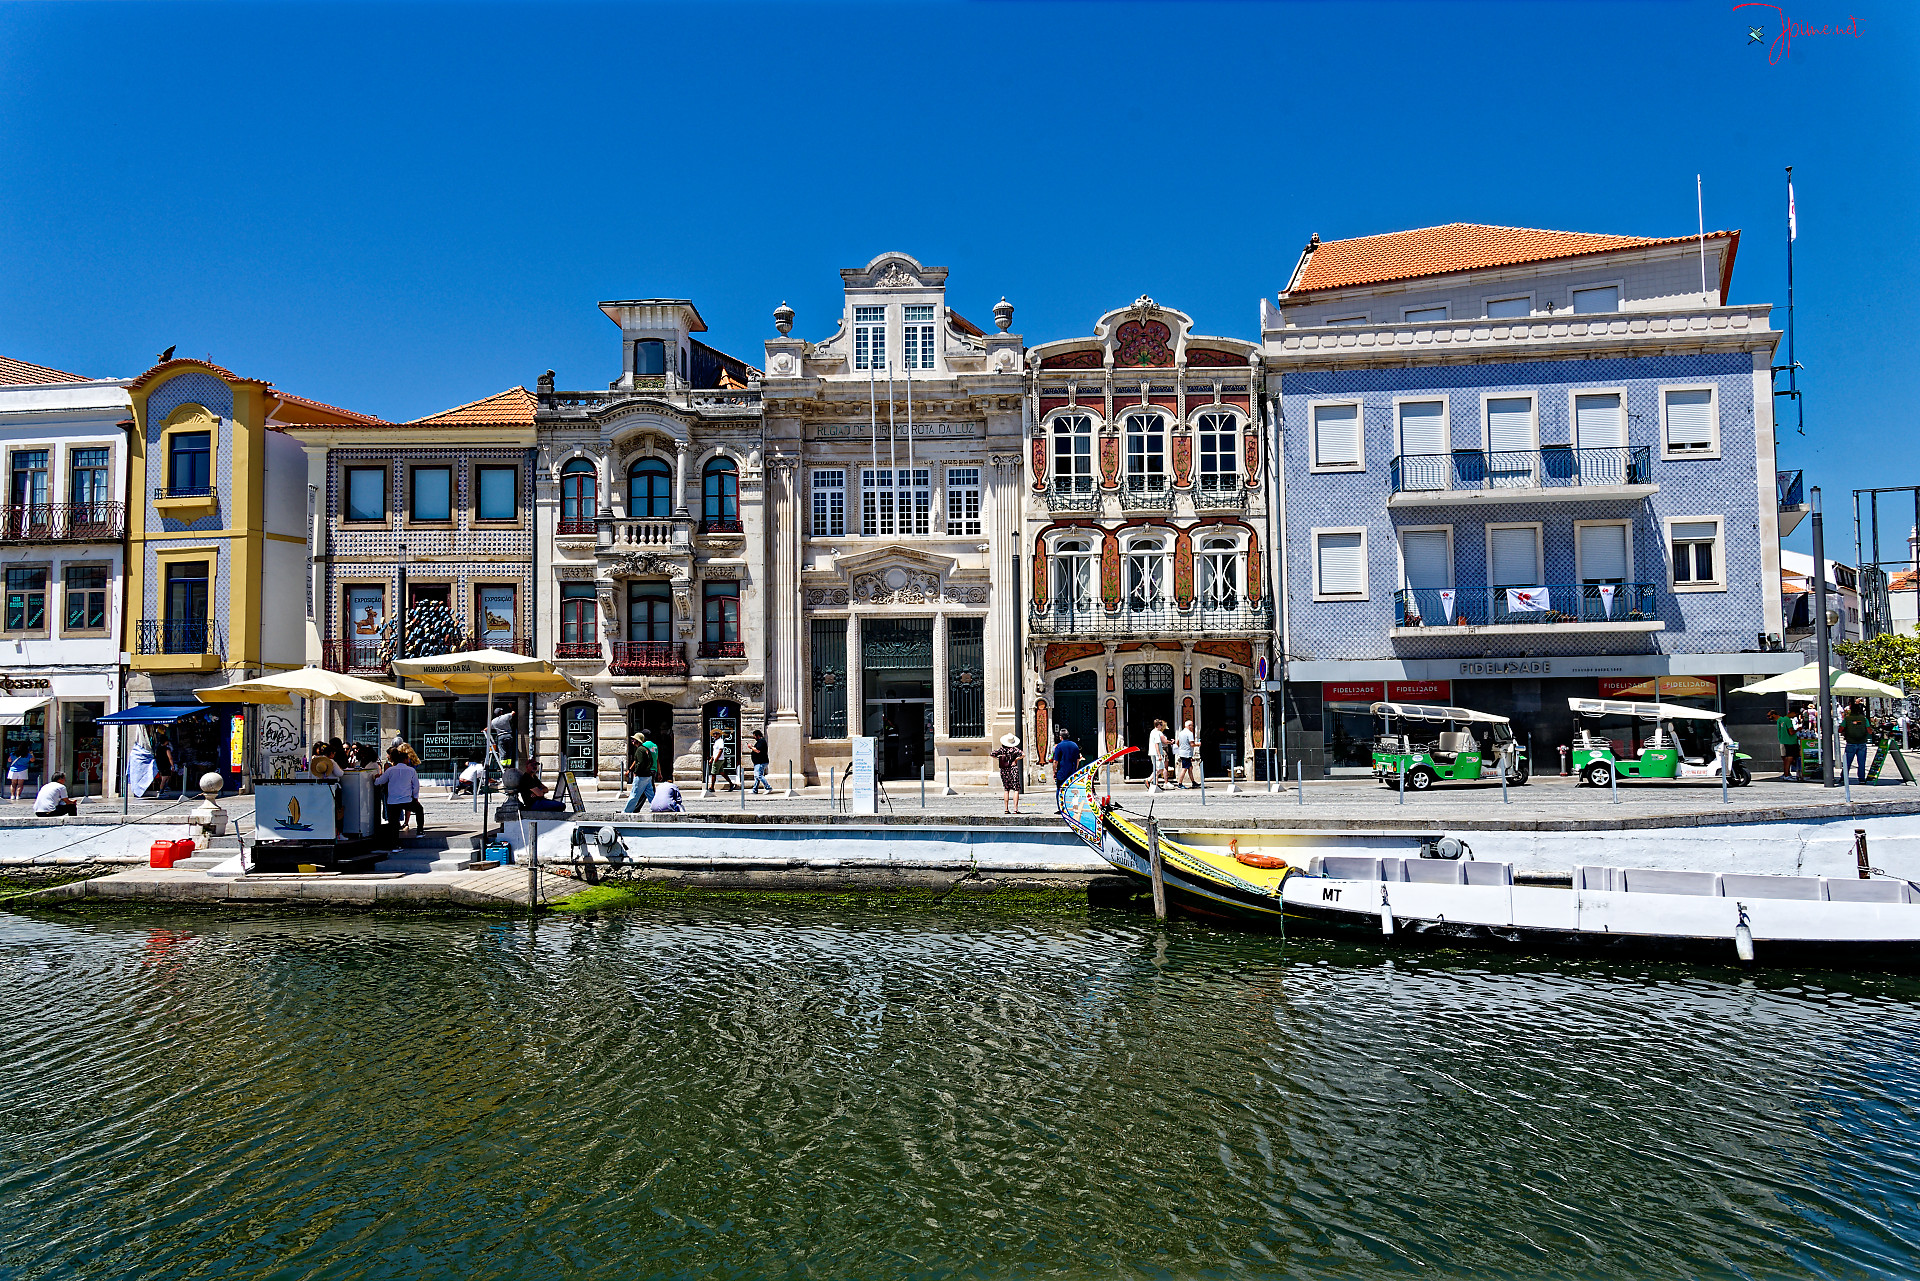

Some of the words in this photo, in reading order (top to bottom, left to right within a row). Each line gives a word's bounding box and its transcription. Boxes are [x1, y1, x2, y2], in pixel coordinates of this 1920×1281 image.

[912, 424, 935, 435] ROTA
[938, 424, 951, 434] DA
[955, 423, 975, 434] LUZ
[307, 512, 315, 551] CIDADE
[423, 665, 452, 673] MEMÓRIAS
[462, 664, 471, 672] RIA
[1460, 661, 1551, 675] FIDELIDADE
[1322, 887, 1343, 902] MT
